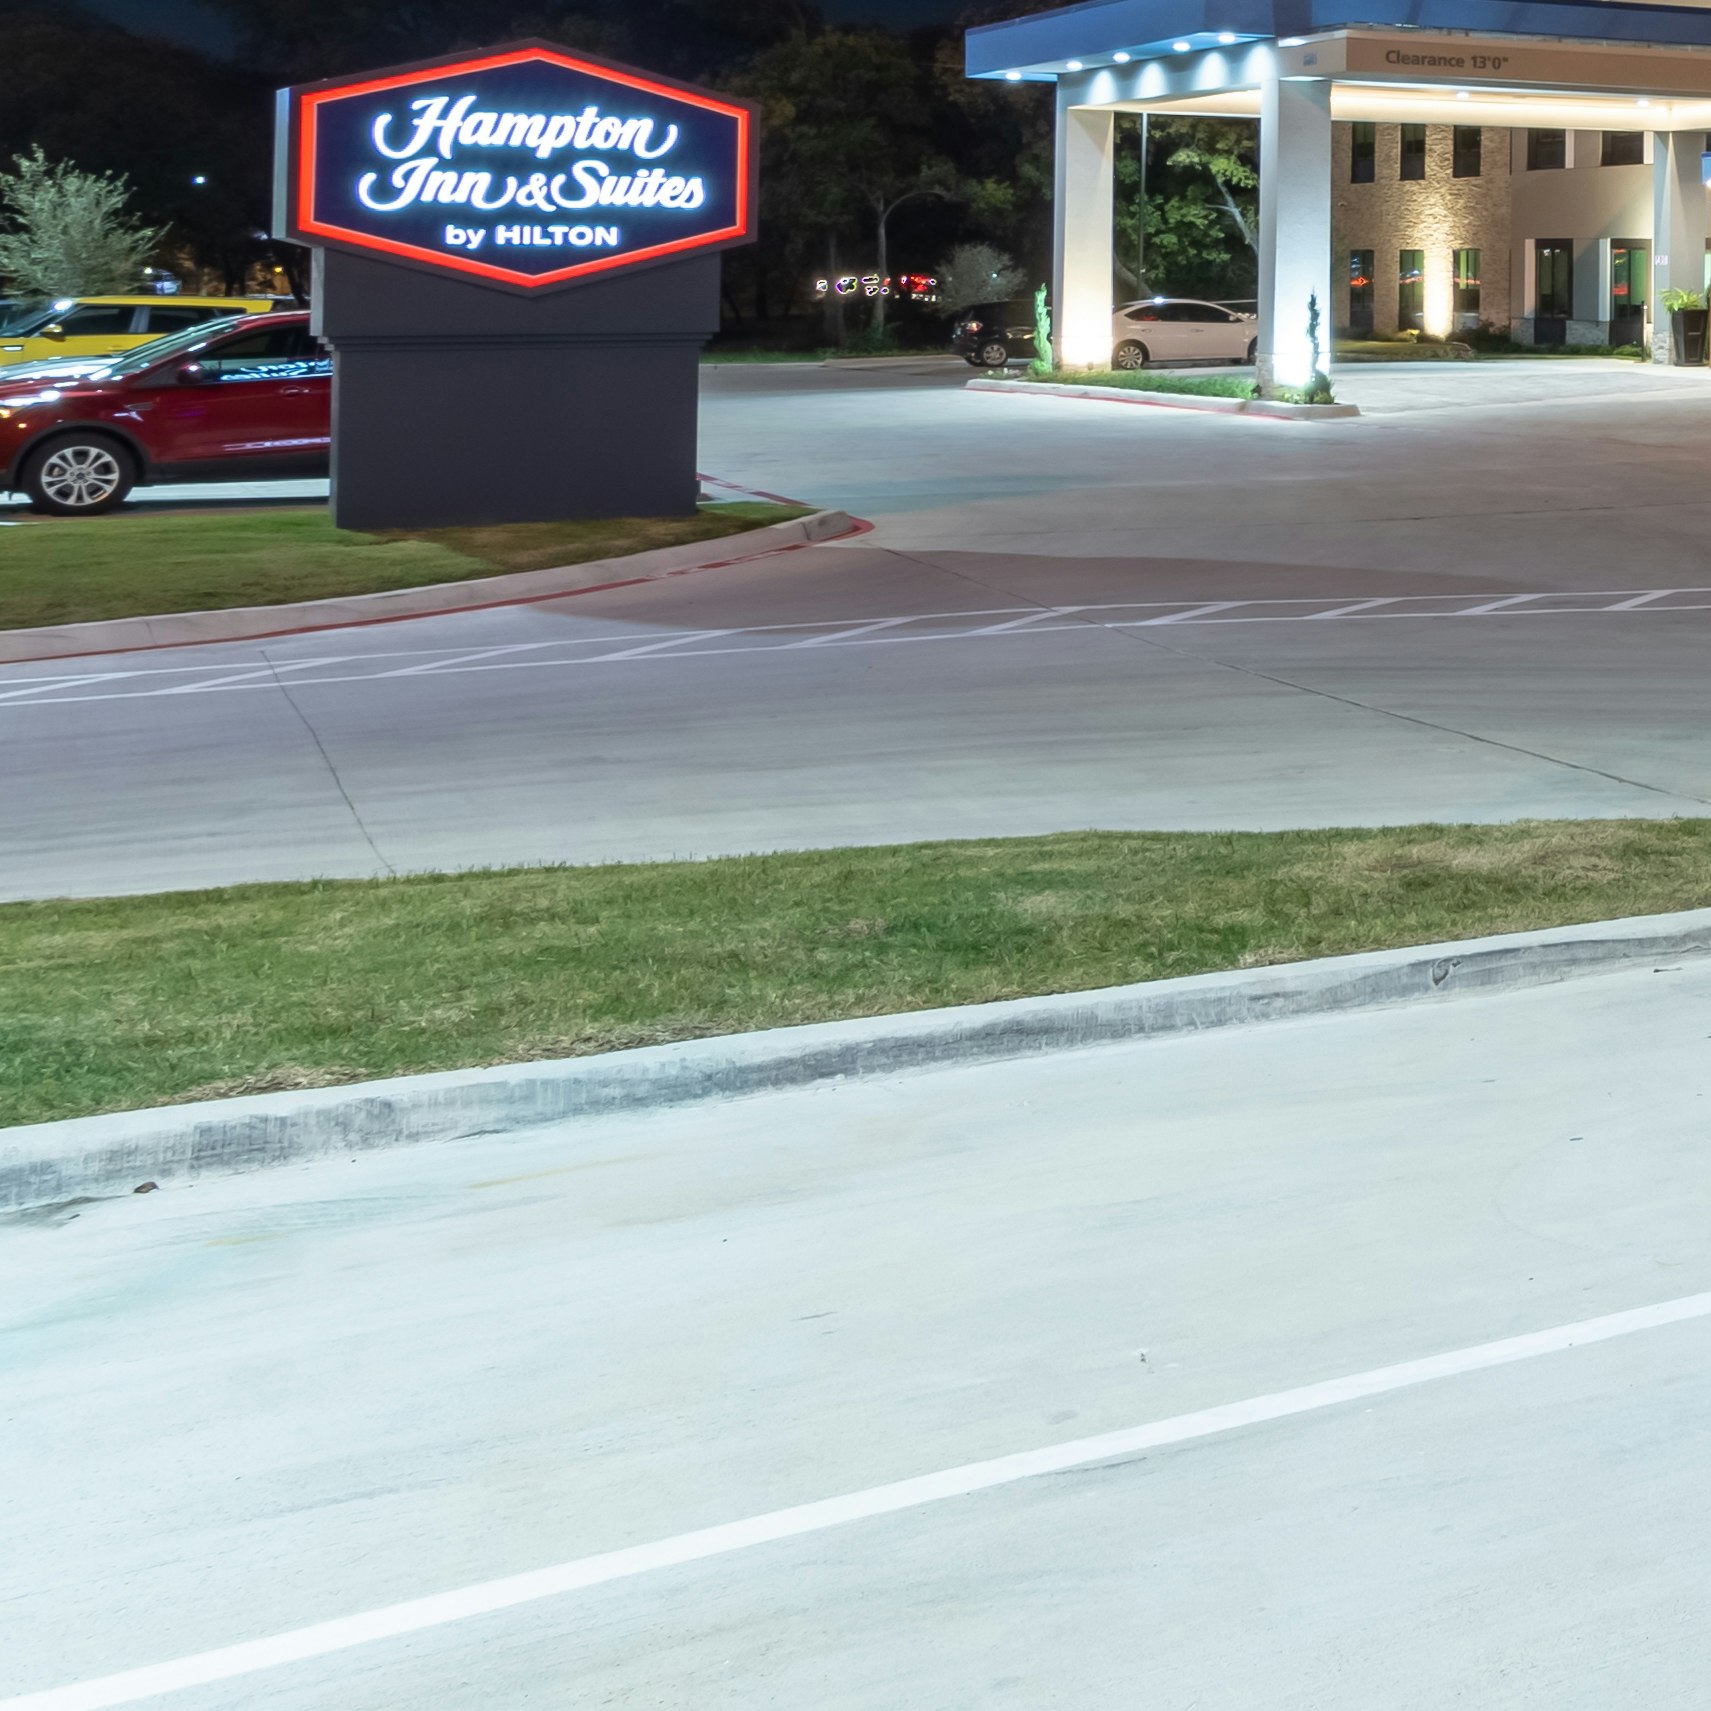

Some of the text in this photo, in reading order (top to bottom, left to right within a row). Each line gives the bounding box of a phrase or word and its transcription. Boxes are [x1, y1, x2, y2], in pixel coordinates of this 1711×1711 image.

[1384, 49, 1510, 71] Clearance 13'0"
[373, 94, 679, 159] Hampton
[357, 156, 706, 212] Inn & Suites
[444, 224, 619, 250] by HILTON
